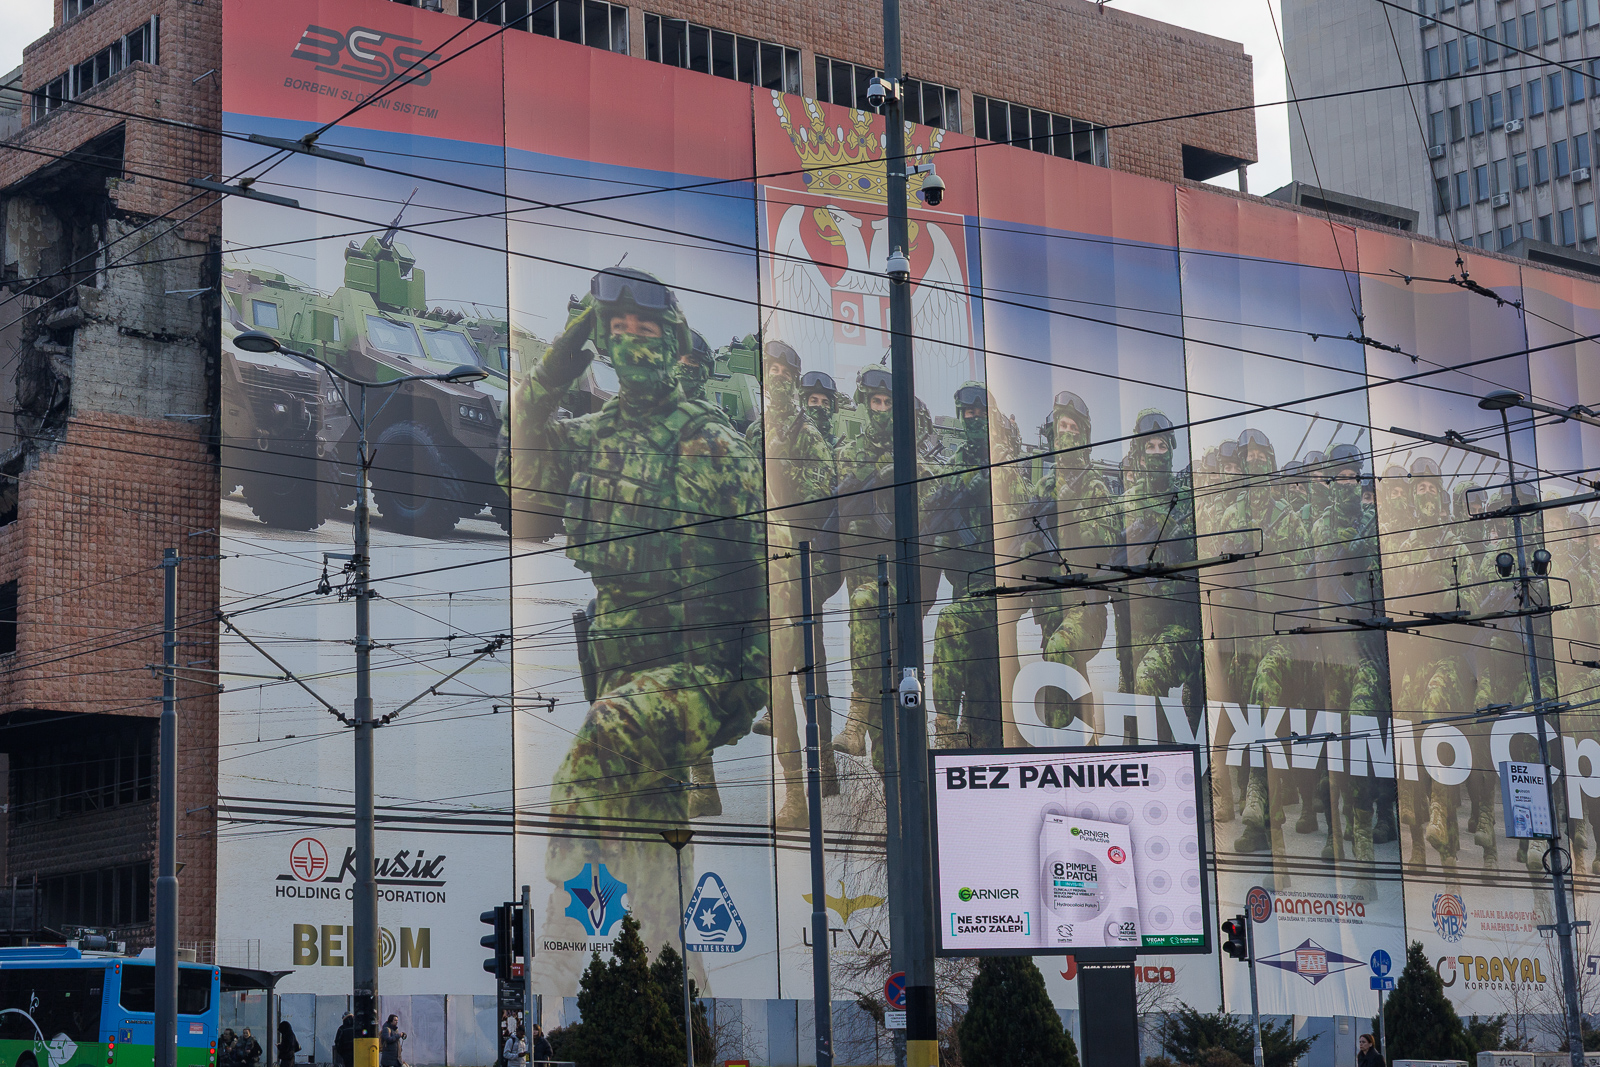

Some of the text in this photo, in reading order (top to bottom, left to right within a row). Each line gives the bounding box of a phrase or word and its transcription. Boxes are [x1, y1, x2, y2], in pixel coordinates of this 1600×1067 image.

[283, 77, 439, 119] BORBENI SLOŽENI SISTEMI
[1511, 765, 1528, 774] BEZ
[946, 763, 1150, 790] BEZ PANIKE!
[1511, 775, 1544, 785] PANIKE!
[1070, 827, 1109, 839] GARNIER
[1054, 863, 1097, 876] 8 PIMPLE
[1066, 871, 1098, 881] PATCH
[275, 885, 446, 904] HOLDING CPORATION
[958, 887, 1019, 902] GARNIER
[683, 886, 703, 926] PRVA
[719, 885, 742, 928] ISKRA
[1274, 898, 1366, 917] namenska
[957, 915, 1024, 926] NE STISKAJ,
[1119, 922, 1136, 931] x22
[1441, 915, 1459, 935] MB
[957, 924, 1024, 934] SAMO ZALEPI
[543, 940, 588, 952] КОВАЧКИ
[692, 944, 736, 953] NAMENSKA
[1297, 954, 1327, 971] FAP
[1458, 955, 1547, 984] TRAYAL
[1464, 982, 1545, 992] KORPORACIJA AD
